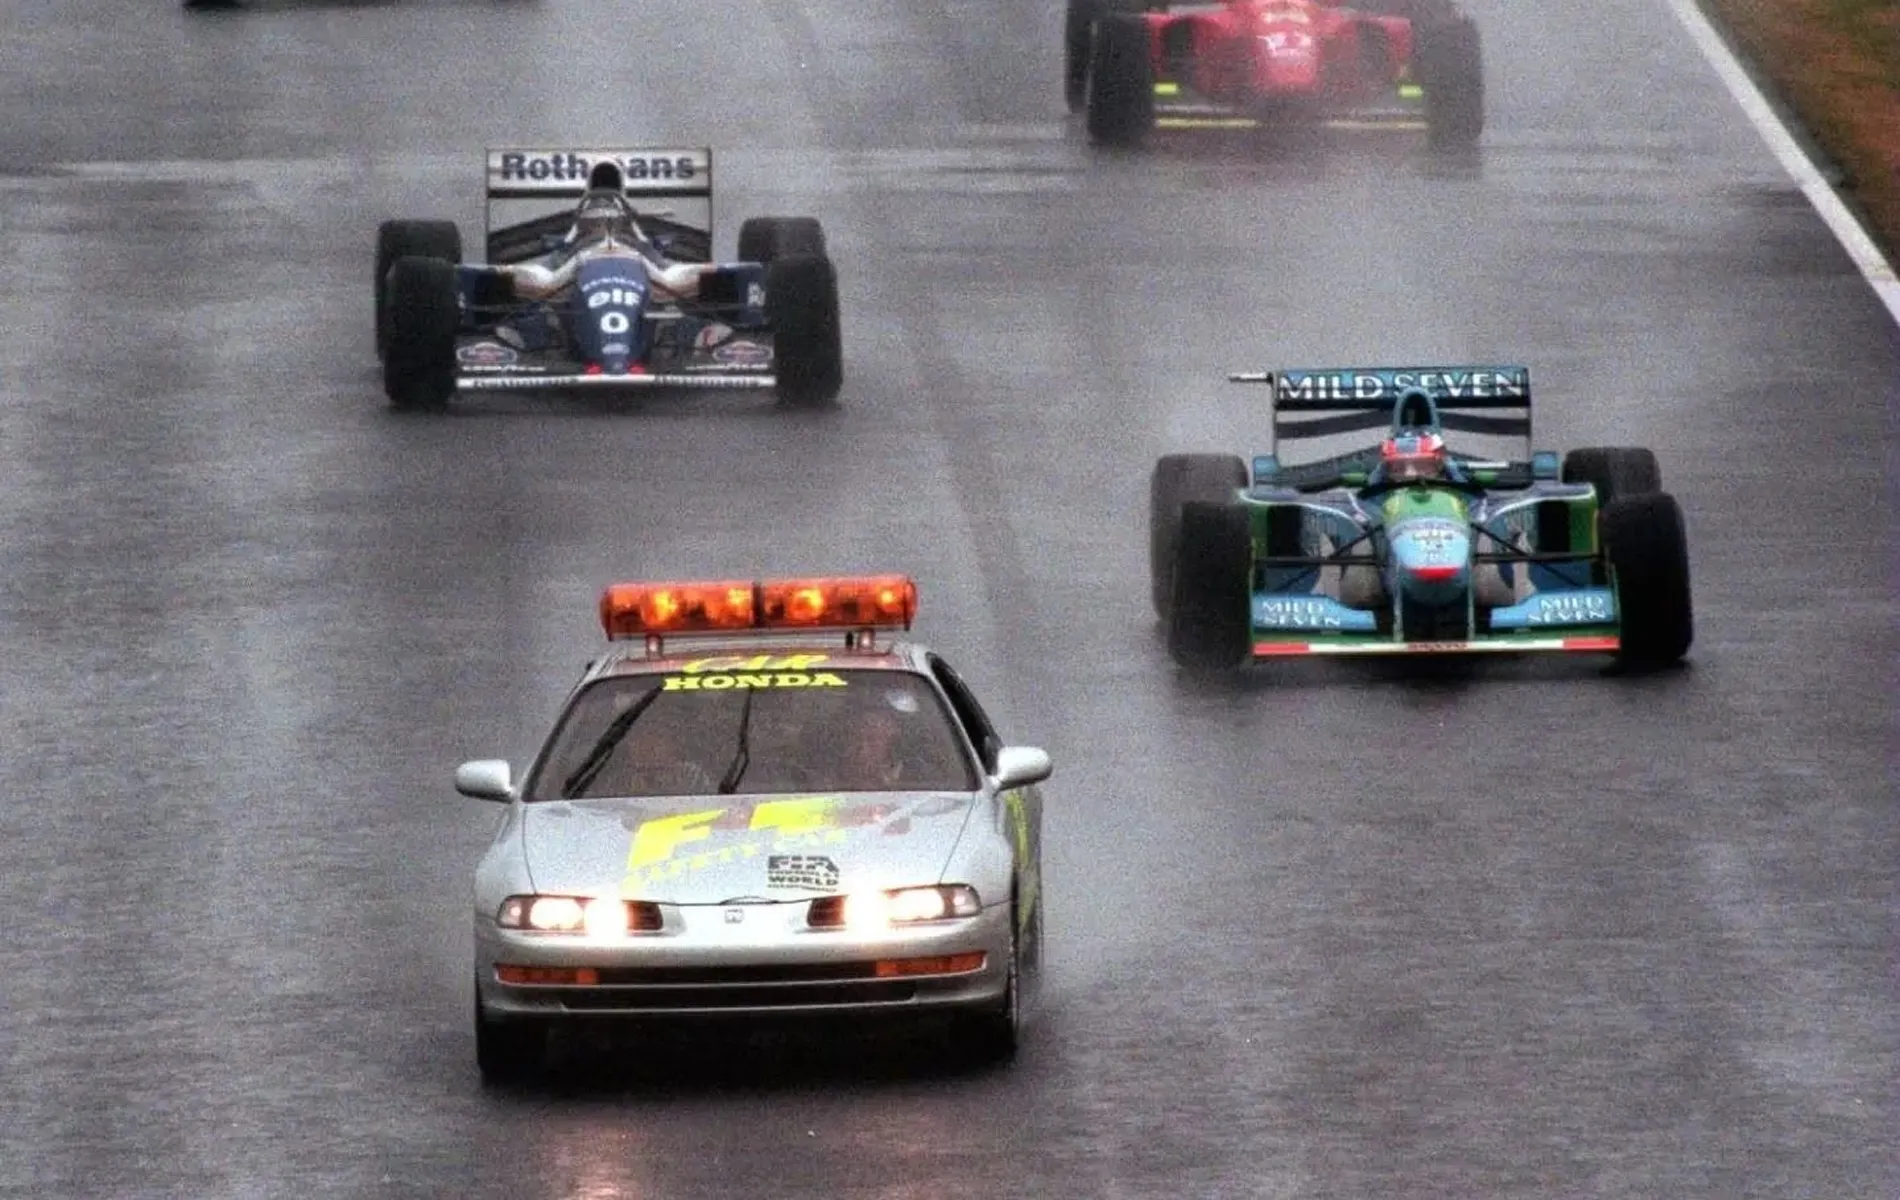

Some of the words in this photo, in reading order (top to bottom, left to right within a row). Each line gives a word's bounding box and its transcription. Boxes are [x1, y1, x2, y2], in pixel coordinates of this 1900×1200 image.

[502, 153, 694, 180] Rothans
[1279, 375, 1384, 400] MILD
[1394, 373, 1522, 397] SEVEN
[663, 672, 849, 691] HONDA
